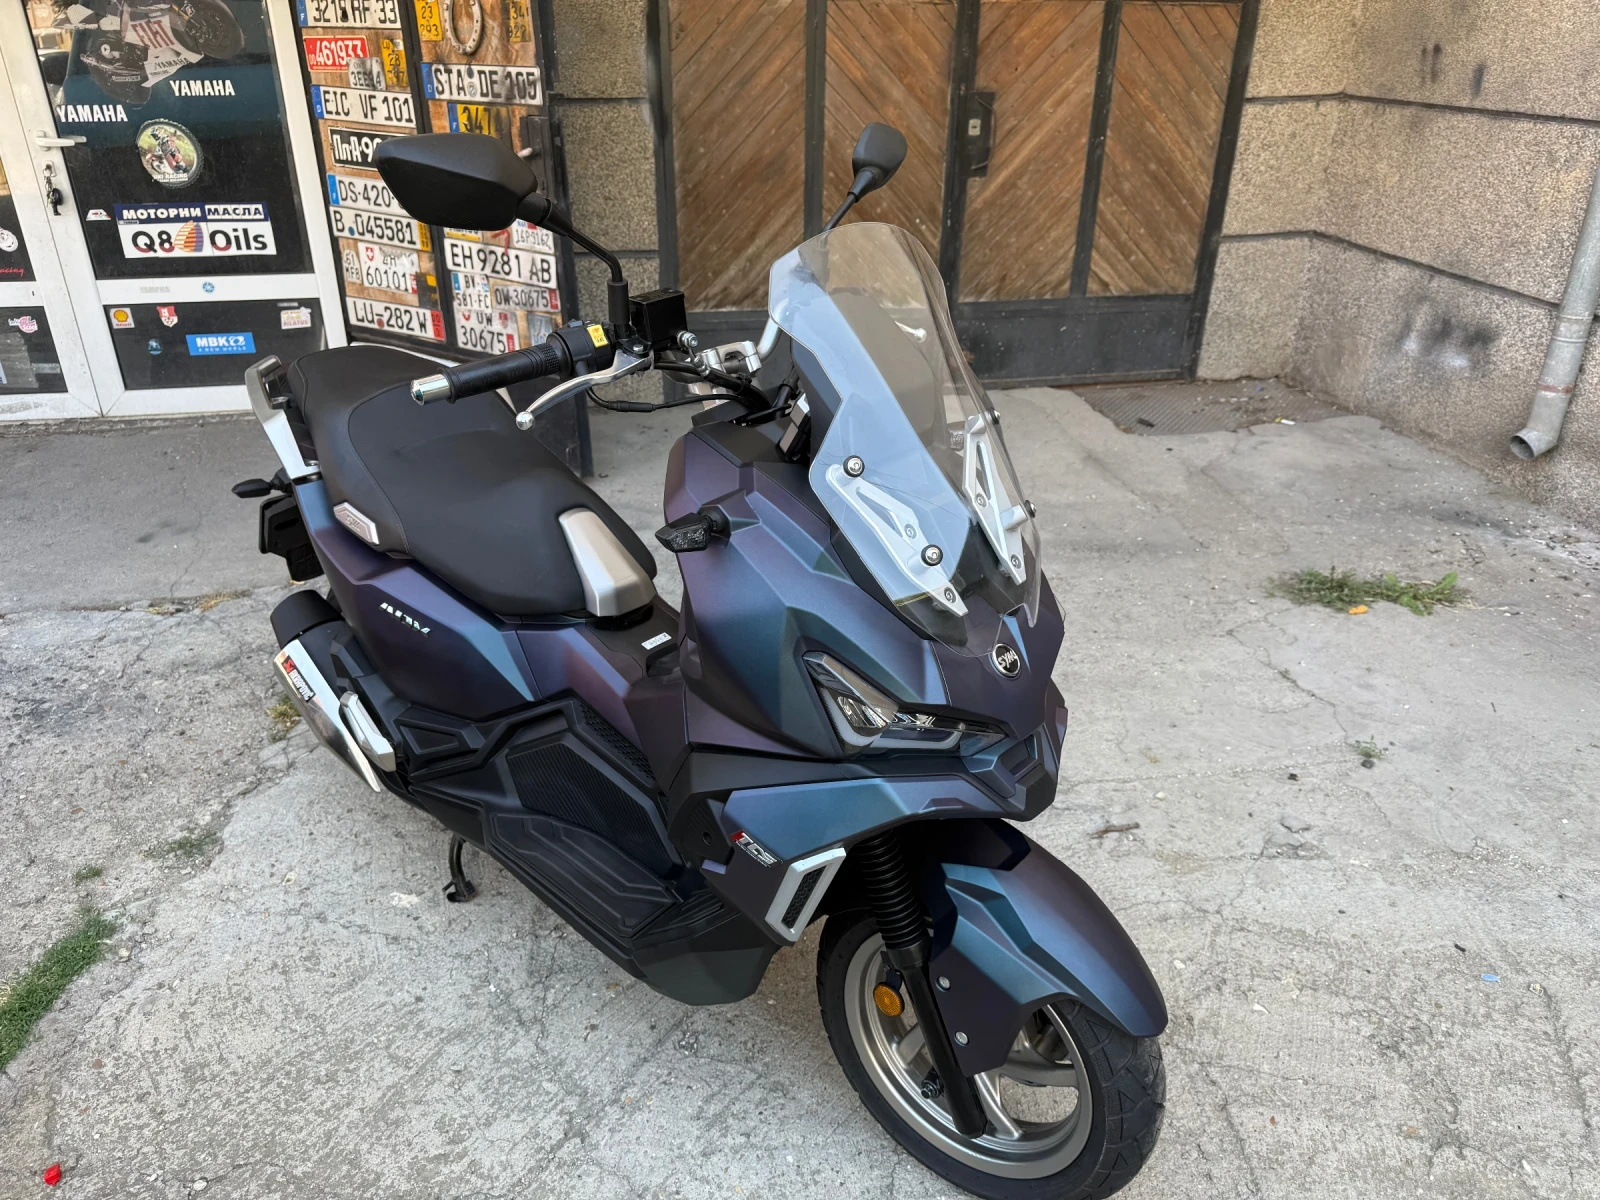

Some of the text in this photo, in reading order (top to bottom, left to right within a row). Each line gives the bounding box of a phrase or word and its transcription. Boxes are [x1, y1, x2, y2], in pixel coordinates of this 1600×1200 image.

[376, 0, 398, 23] 33
[420, 5, 434, 20] 23
[131, 20, 175, 49] FIAT
[153, 57, 191, 71] YAMAHA
[169, 79, 236, 97] YAMAHA
[433, 67, 537, 100] STA DE 105
[56, 104, 128, 122] YAMAHA
[322, 89, 414, 123] EIC VF 101
[122, 206, 264, 220] МОТОРНИ МАСЛА
[333, 210, 345, 233] B
[354, 213, 416, 246] 045581
[131, 228, 268, 253] Q8 Oils
[365, 265, 409, 292] 60101
[529, 256, 552, 284] AB
[195, 336, 229, 348] MBK
[460, 325, 506, 353] 30675
[997, 649, 1019, 669] SYM
